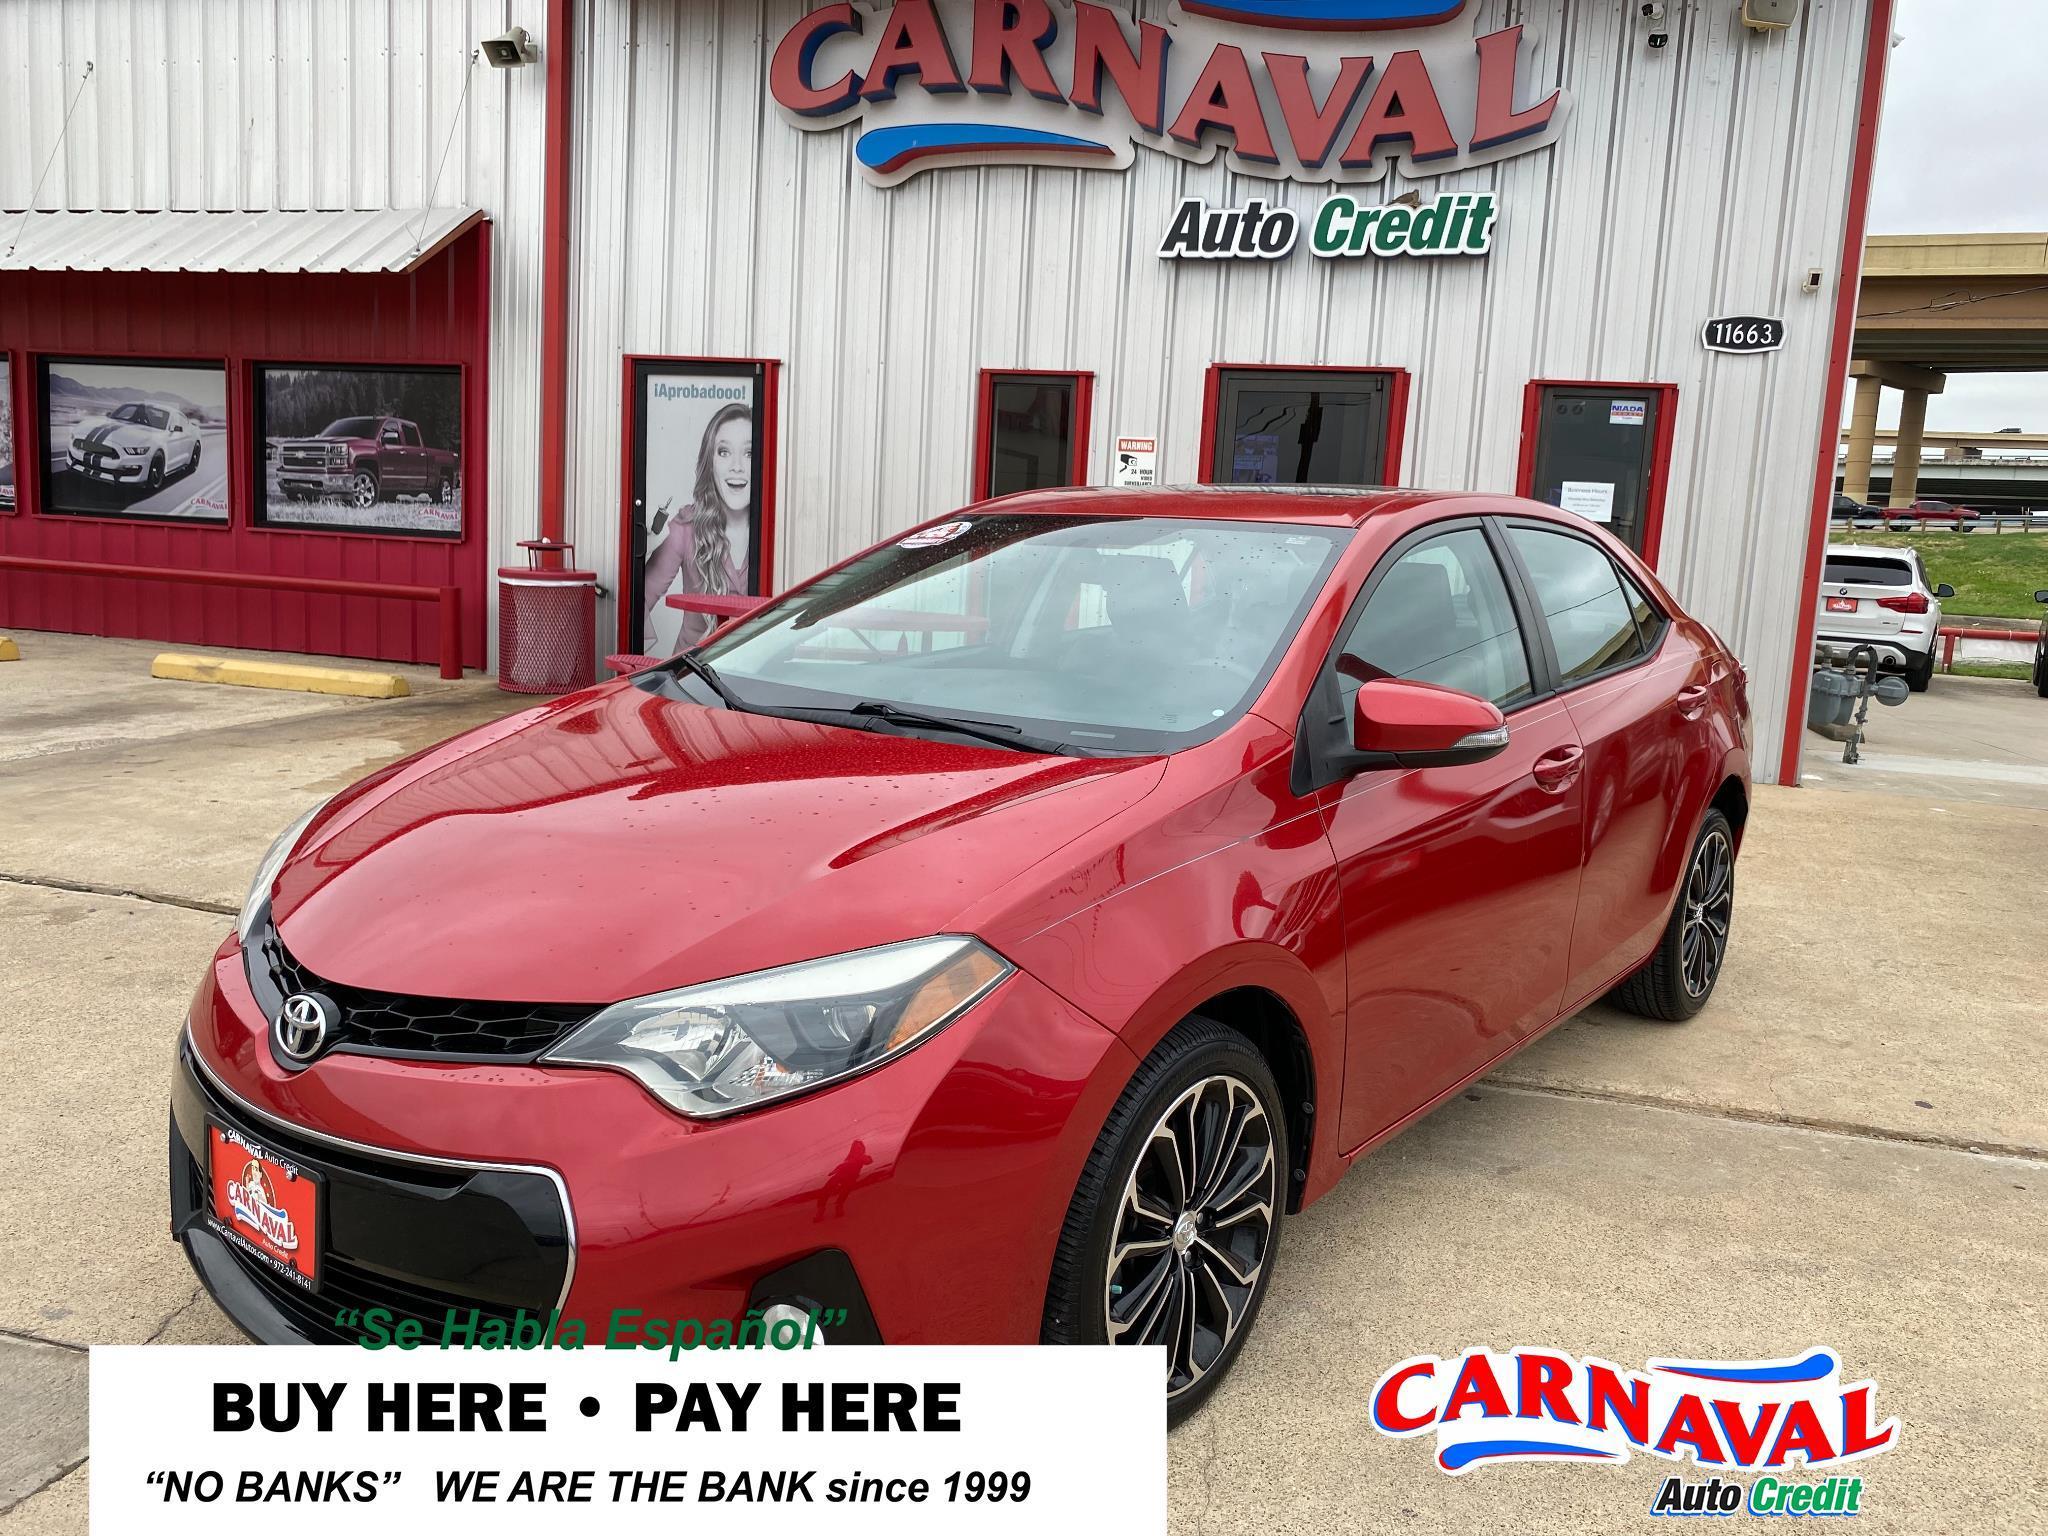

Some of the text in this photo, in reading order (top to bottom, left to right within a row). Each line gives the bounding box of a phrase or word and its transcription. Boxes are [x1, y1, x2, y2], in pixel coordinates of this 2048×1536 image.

[770, 0, 1560, 168] CARNAVAL
[1161, 196, 1495, 253] Auto Credit
[1716, 323, 1772, 344] 11663
[654, 383, 747, 401] ¡Aprobadooo!
[1120, 440, 1153, 451] WARNING
[227, 1129, 299, 1176] CARNAVAL Auto Credit
[227, 1181, 297, 1244] CARNAVAL
[273, 1260, 312, 1290] 972-241-8141
